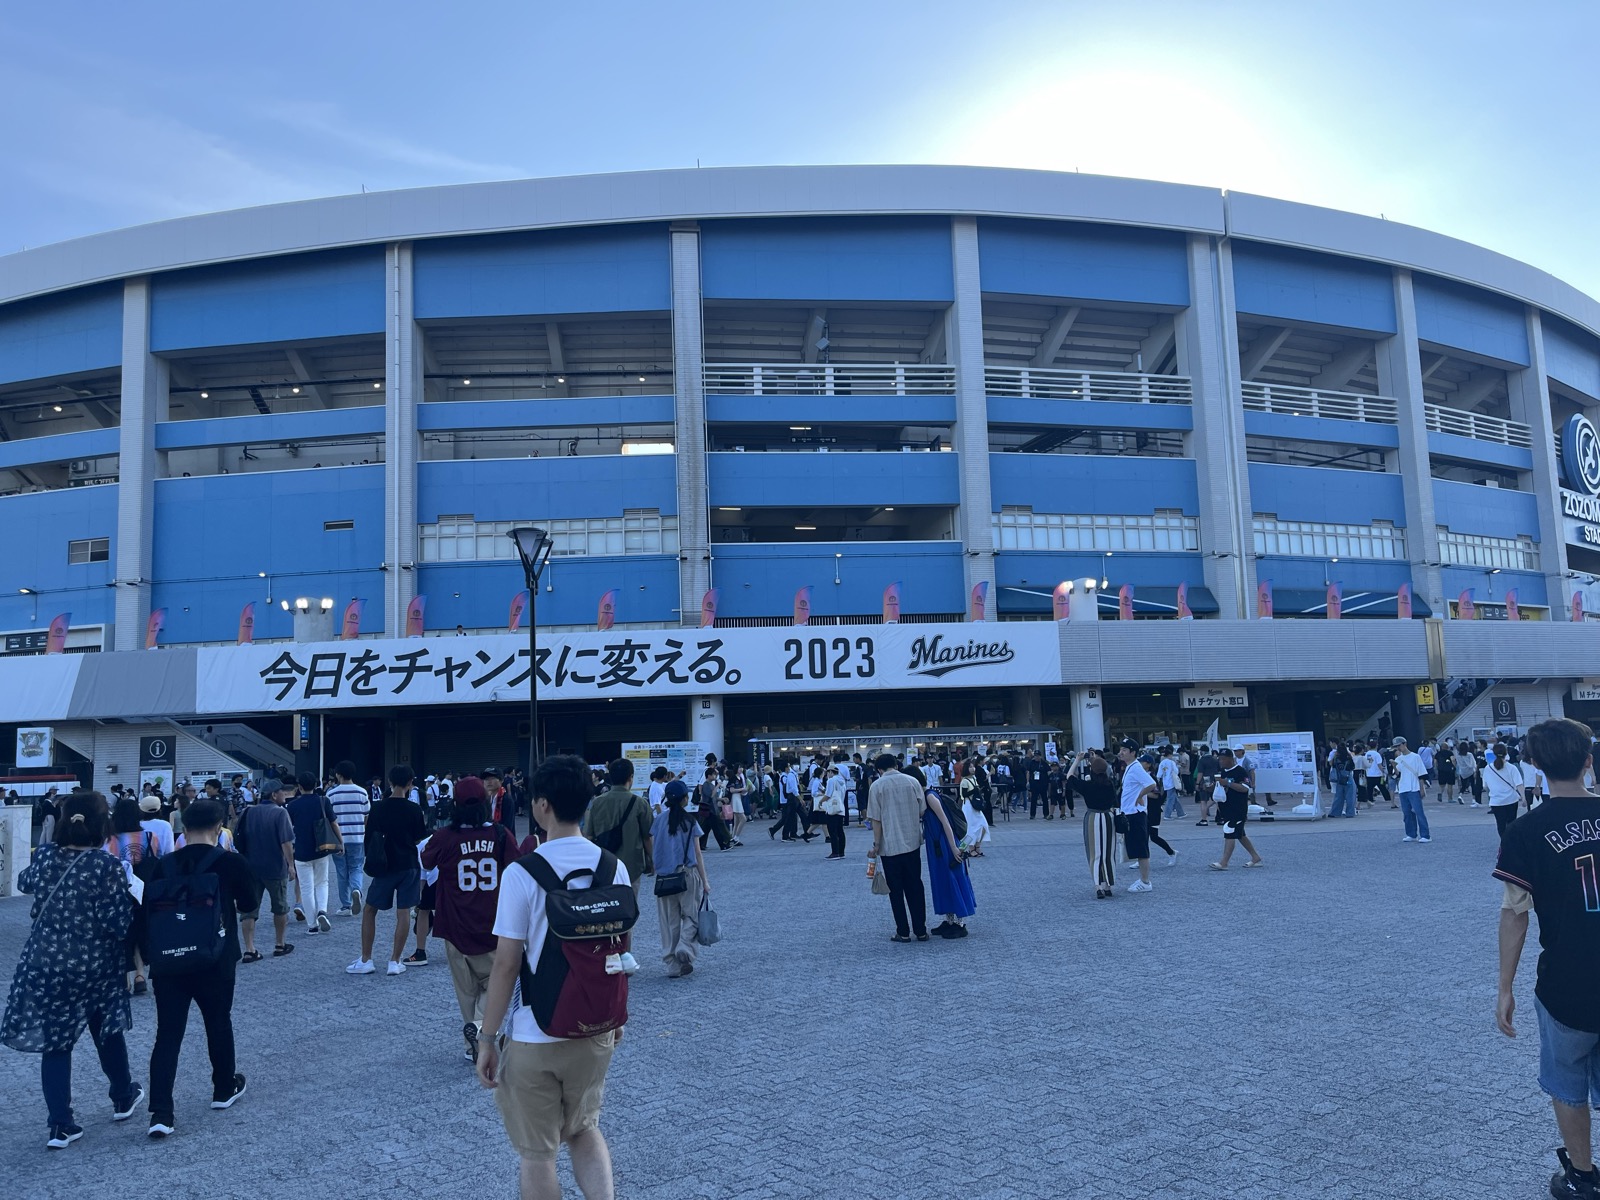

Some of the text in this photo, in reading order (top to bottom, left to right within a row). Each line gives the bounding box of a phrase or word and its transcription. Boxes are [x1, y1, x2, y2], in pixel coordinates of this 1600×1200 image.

[26, 636, 31, 645] E
[906, 633, 1014, 676] Marines
[259, 636, 875, 701] 今日をチャンスに変える。 2023
[1423, 685, 1430, 694] D
[460, 839, 494, 855] BLASH
[457, 858, 498, 891] 69
